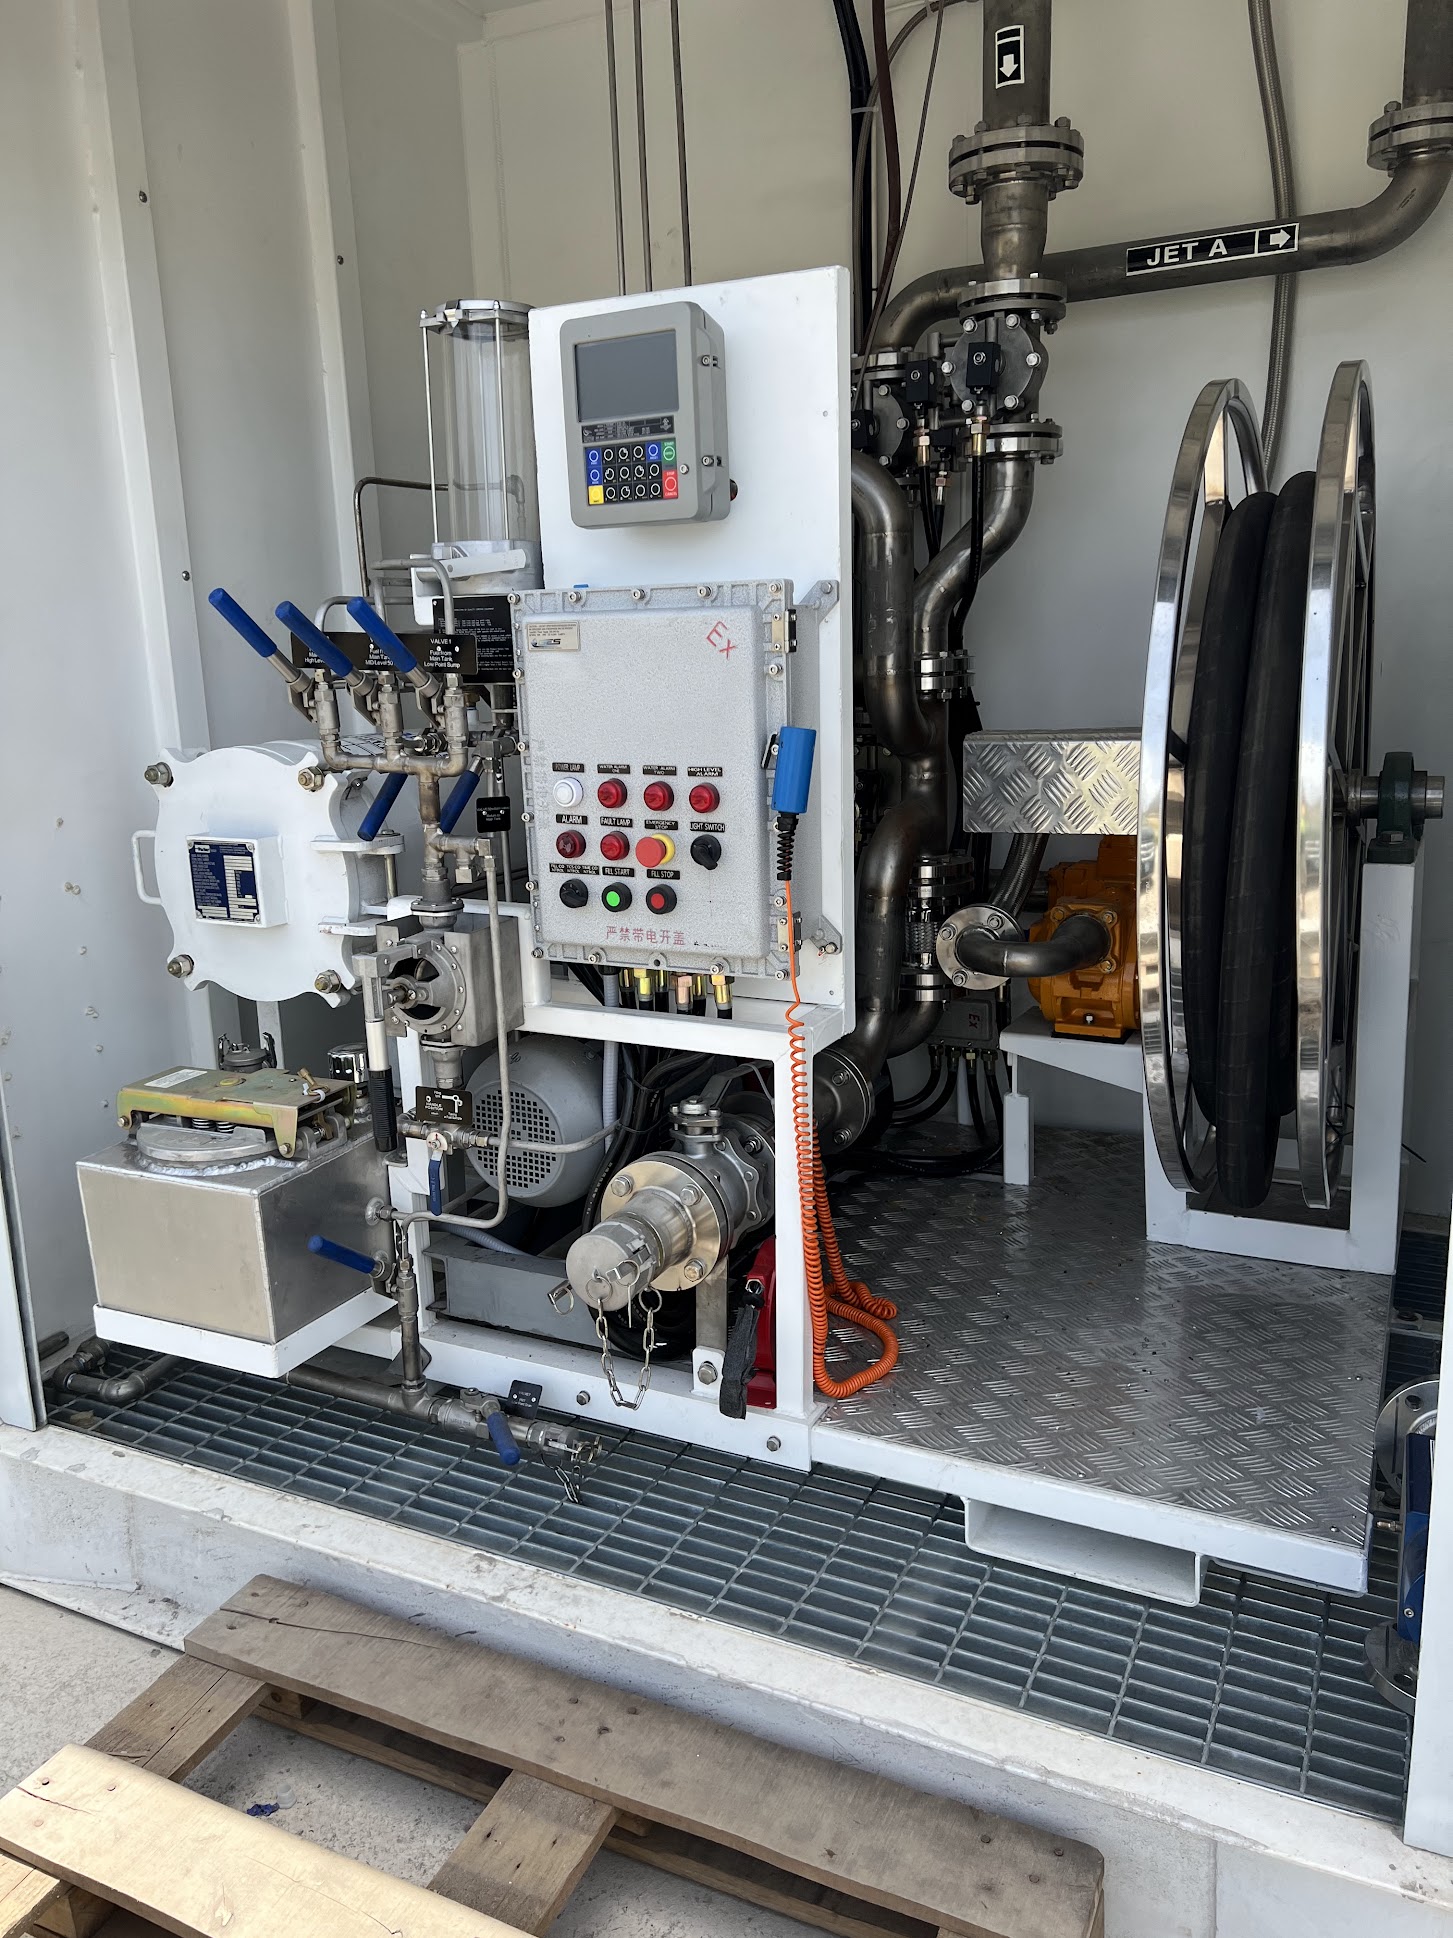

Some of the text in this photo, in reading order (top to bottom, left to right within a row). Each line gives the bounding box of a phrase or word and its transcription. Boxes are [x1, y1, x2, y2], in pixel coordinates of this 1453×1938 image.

[1146, 238, 1228, 266] JET A
[706, 620, 737, 660] Ex
[562, 815, 582, 824] ALARM
[600, 817, 631, 826] FAULT LAMP
[704, 823, 725, 831] SWITCH
[606, 926, 686, 946] 严禁带电开盖
